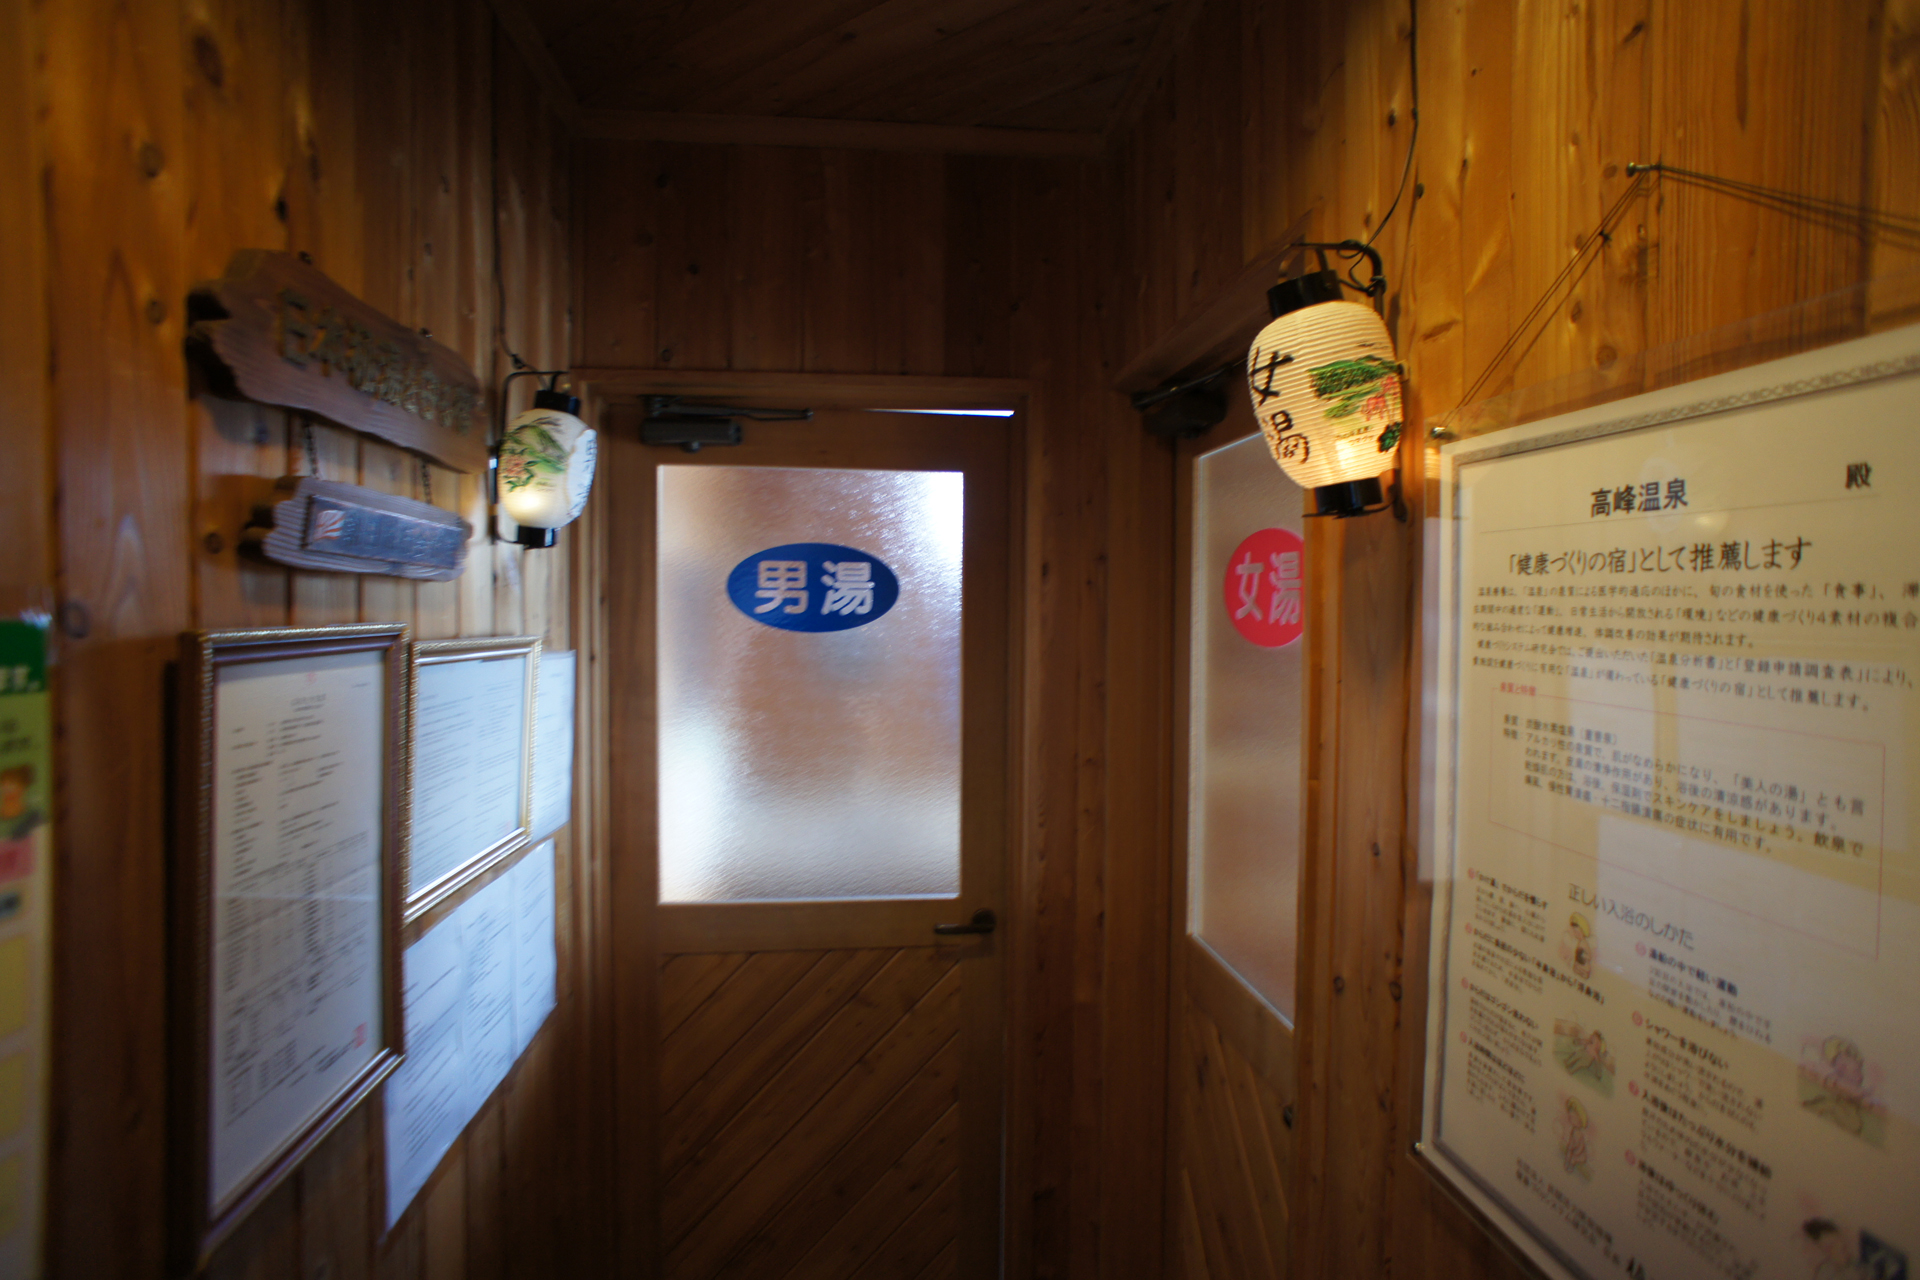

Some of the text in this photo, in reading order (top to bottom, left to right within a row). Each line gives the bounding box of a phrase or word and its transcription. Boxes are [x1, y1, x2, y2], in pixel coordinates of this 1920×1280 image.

[1590, 462, 1872, 518] 高峰温泉 殿
[754, 560, 875, 616] 男湯
[1235, 551, 1301, 625] 女湯
[1568, 882, 1694, 951] 正しい入浴のしかた
